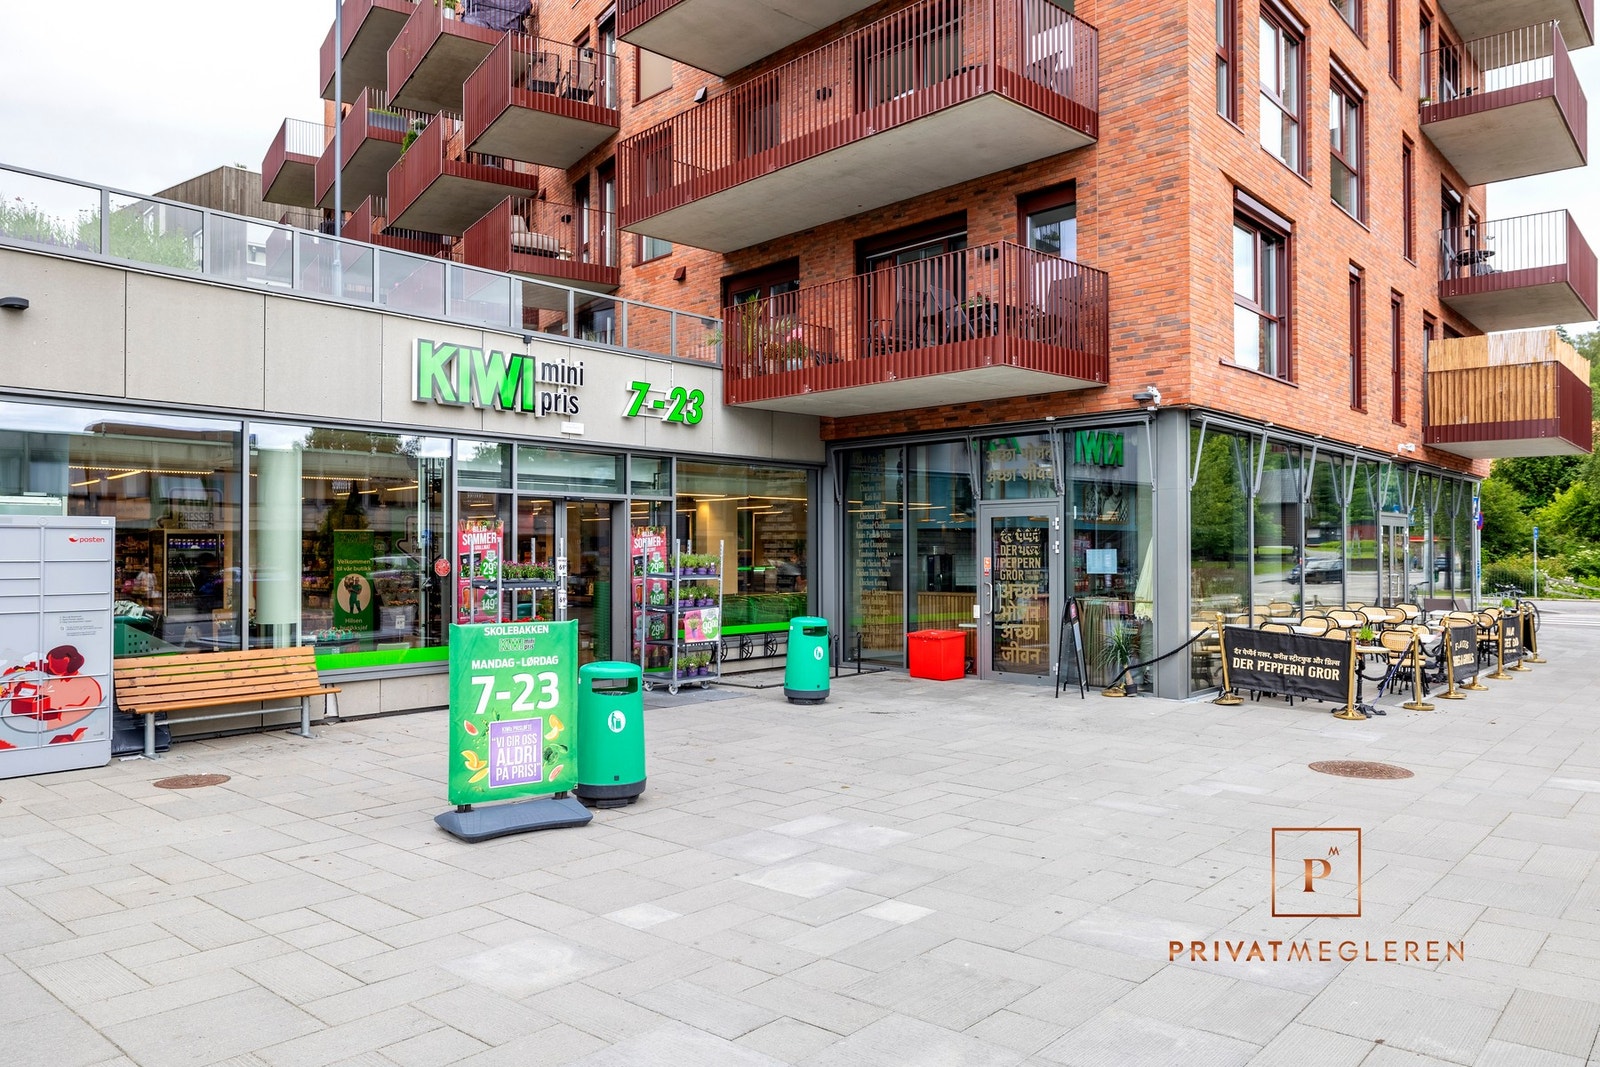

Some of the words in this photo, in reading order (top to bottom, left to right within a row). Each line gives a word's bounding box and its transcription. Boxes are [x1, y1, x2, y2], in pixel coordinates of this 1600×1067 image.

[412, 338, 536, 413] KIWI
[540, 358, 584, 387] mini
[540, 387, 580, 417] pris
[624, 380, 705, 425] 7-23
[79, 536, 105, 544] posten
[1000, 544, 1018, 556] DER
[1000, 557, 1041, 569] PEPPERN
[1000, 569, 1024, 581] GROR
[1001, 583, 1040, 600] अच्छा
[484, 625, 549, 637] SKOLEBAKKEN
[1001, 623, 1041, 641] अच्छा
[1001, 640, 1041, 665] जीवन
[471, 657, 515, 670] MANDAG
[521, 655, 559, 667] LØRDAG
[1232, 657, 1254, 671] DER
[1257, 660, 1305, 676] PEPPERN
[1308, 666, 1340, 681] GROR
[471, 671, 560, 715] 7-23
[506, 734, 520, 747] GIR
[521, 732, 538, 746] OSS
[496, 744, 537, 767] ALDRI
